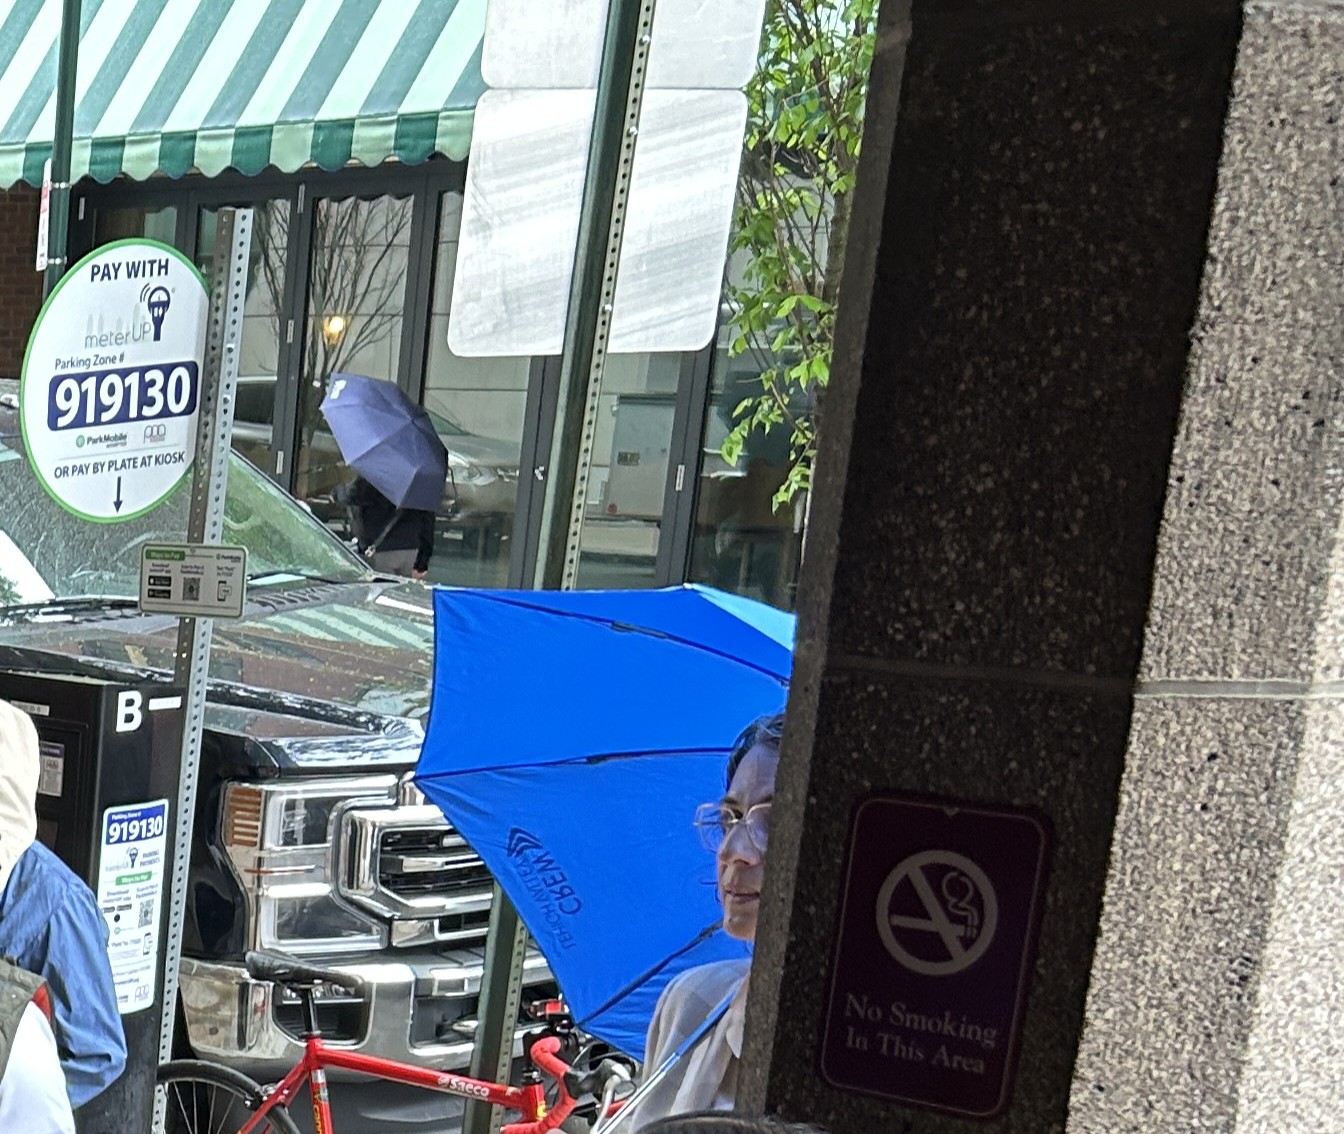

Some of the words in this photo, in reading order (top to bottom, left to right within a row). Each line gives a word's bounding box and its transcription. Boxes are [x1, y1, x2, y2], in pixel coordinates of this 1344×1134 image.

[90, 261, 123, 283] PAY
[126, 258, 170, 280] WITH
[54, 357, 90, 371] Parking
[93, 354, 117, 367] Zone
[119, 352, 125, 363] #
[55, 366, 192, 428] 919130
[86, 432, 127, 446] ParkMobile
[54, 467, 69, 480] OR
[71, 464, 90, 478] PAY
[92, 462, 106, 475] BY
[108, 458, 138, 473] PLATE
[139, 456, 153, 470] AT
[155, 451, 185, 467] KIOSK
[116, 690, 143, 733] B
[109, 815, 163, 843] 919130
[846, 993, 882, 1022] No
[890, 1001, 998, 1049] Smoking
[847, 1025, 868, 1051] In
[876, 1032, 924, 1061] This
[932, 1045, 985, 1074] Area
